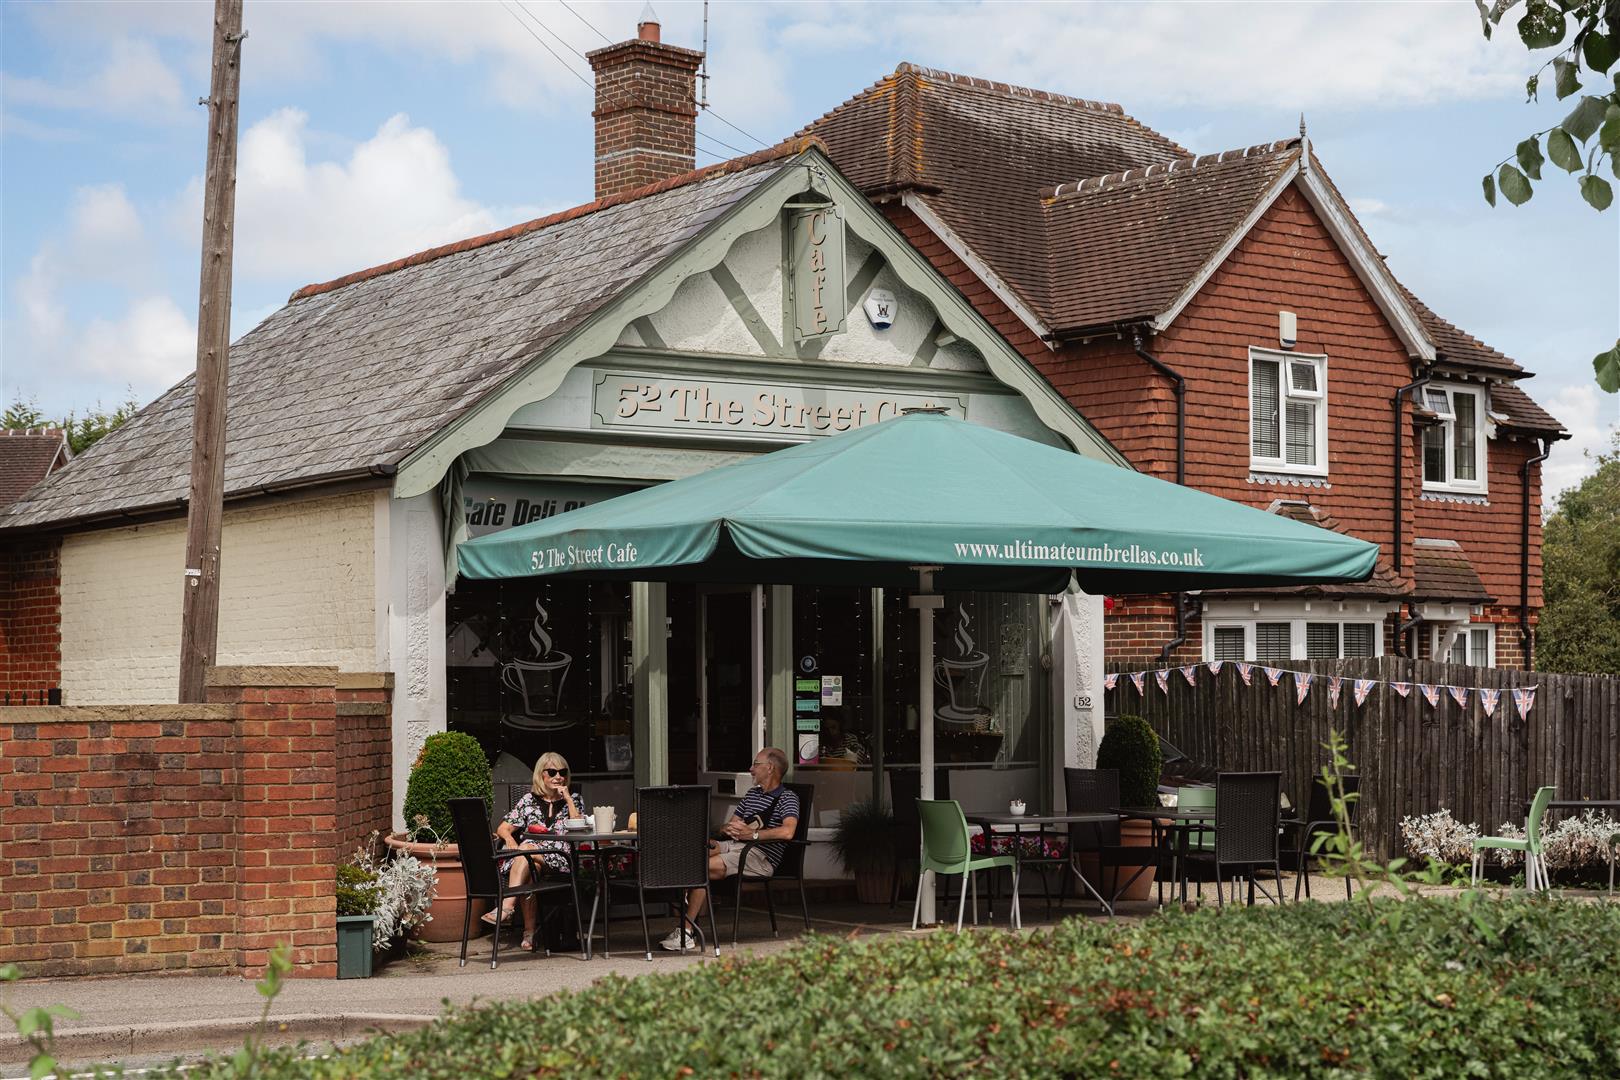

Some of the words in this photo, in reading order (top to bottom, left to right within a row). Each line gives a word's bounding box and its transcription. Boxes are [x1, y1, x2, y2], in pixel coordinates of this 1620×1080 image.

[807, 209, 828, 334] Cafe
[618, 384, 662, 418] 52
[669, 385, 744, 425] The
[752, 392, 867, 431] Street
[531, 551, 545, 570] 52
[547, 547, 565, 567] The
[568, 544, 604, 565] Street
[607, 542, 638, 564] Cafe
[954, 540, 1205, 567] www.ultimateumbrellas.co.uk
[1078, 696, 1092, 707] 52
